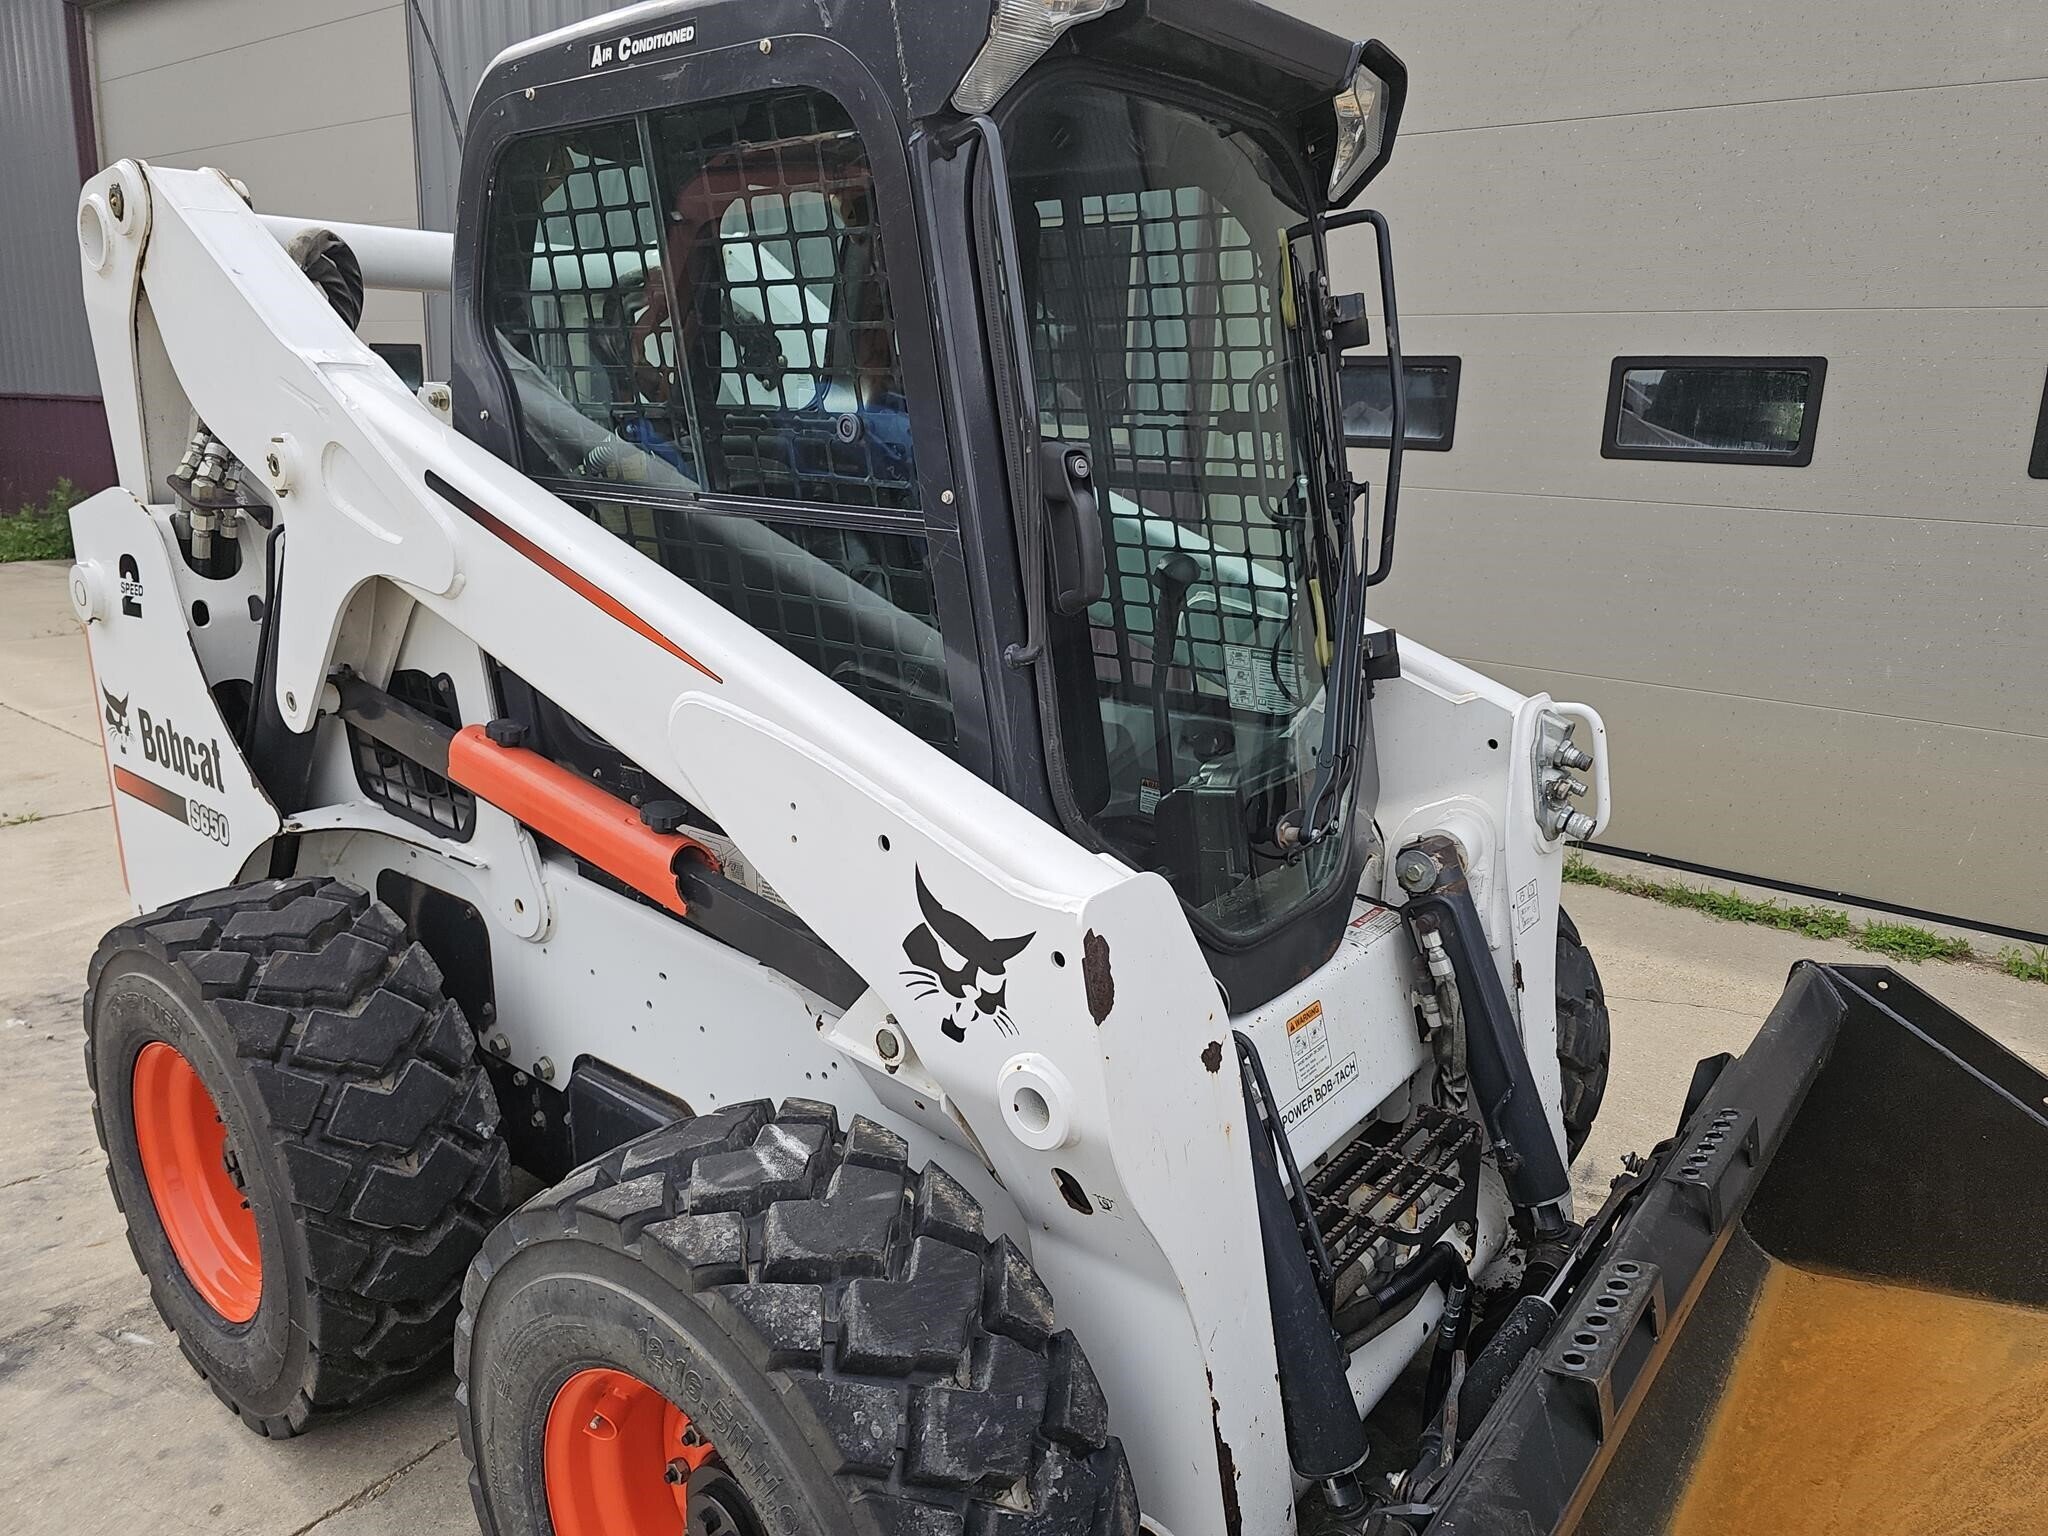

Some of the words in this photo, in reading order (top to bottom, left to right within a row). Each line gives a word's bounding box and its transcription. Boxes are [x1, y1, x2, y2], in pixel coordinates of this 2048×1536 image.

[618, 25, 694, 61] CONDITIONED
[119, 553, 142, 619] 2
[120, 581, 144, 597] SPEED
[138, 707, 225, 794] Bobcat
[189, 799, 230, 847] S650
[1295, 1005, 1320, 1026] WARNING
[1281, 1094, 1315, 1128] POWER
[1315, 1060, 1357, 1101] BOB-TACH
